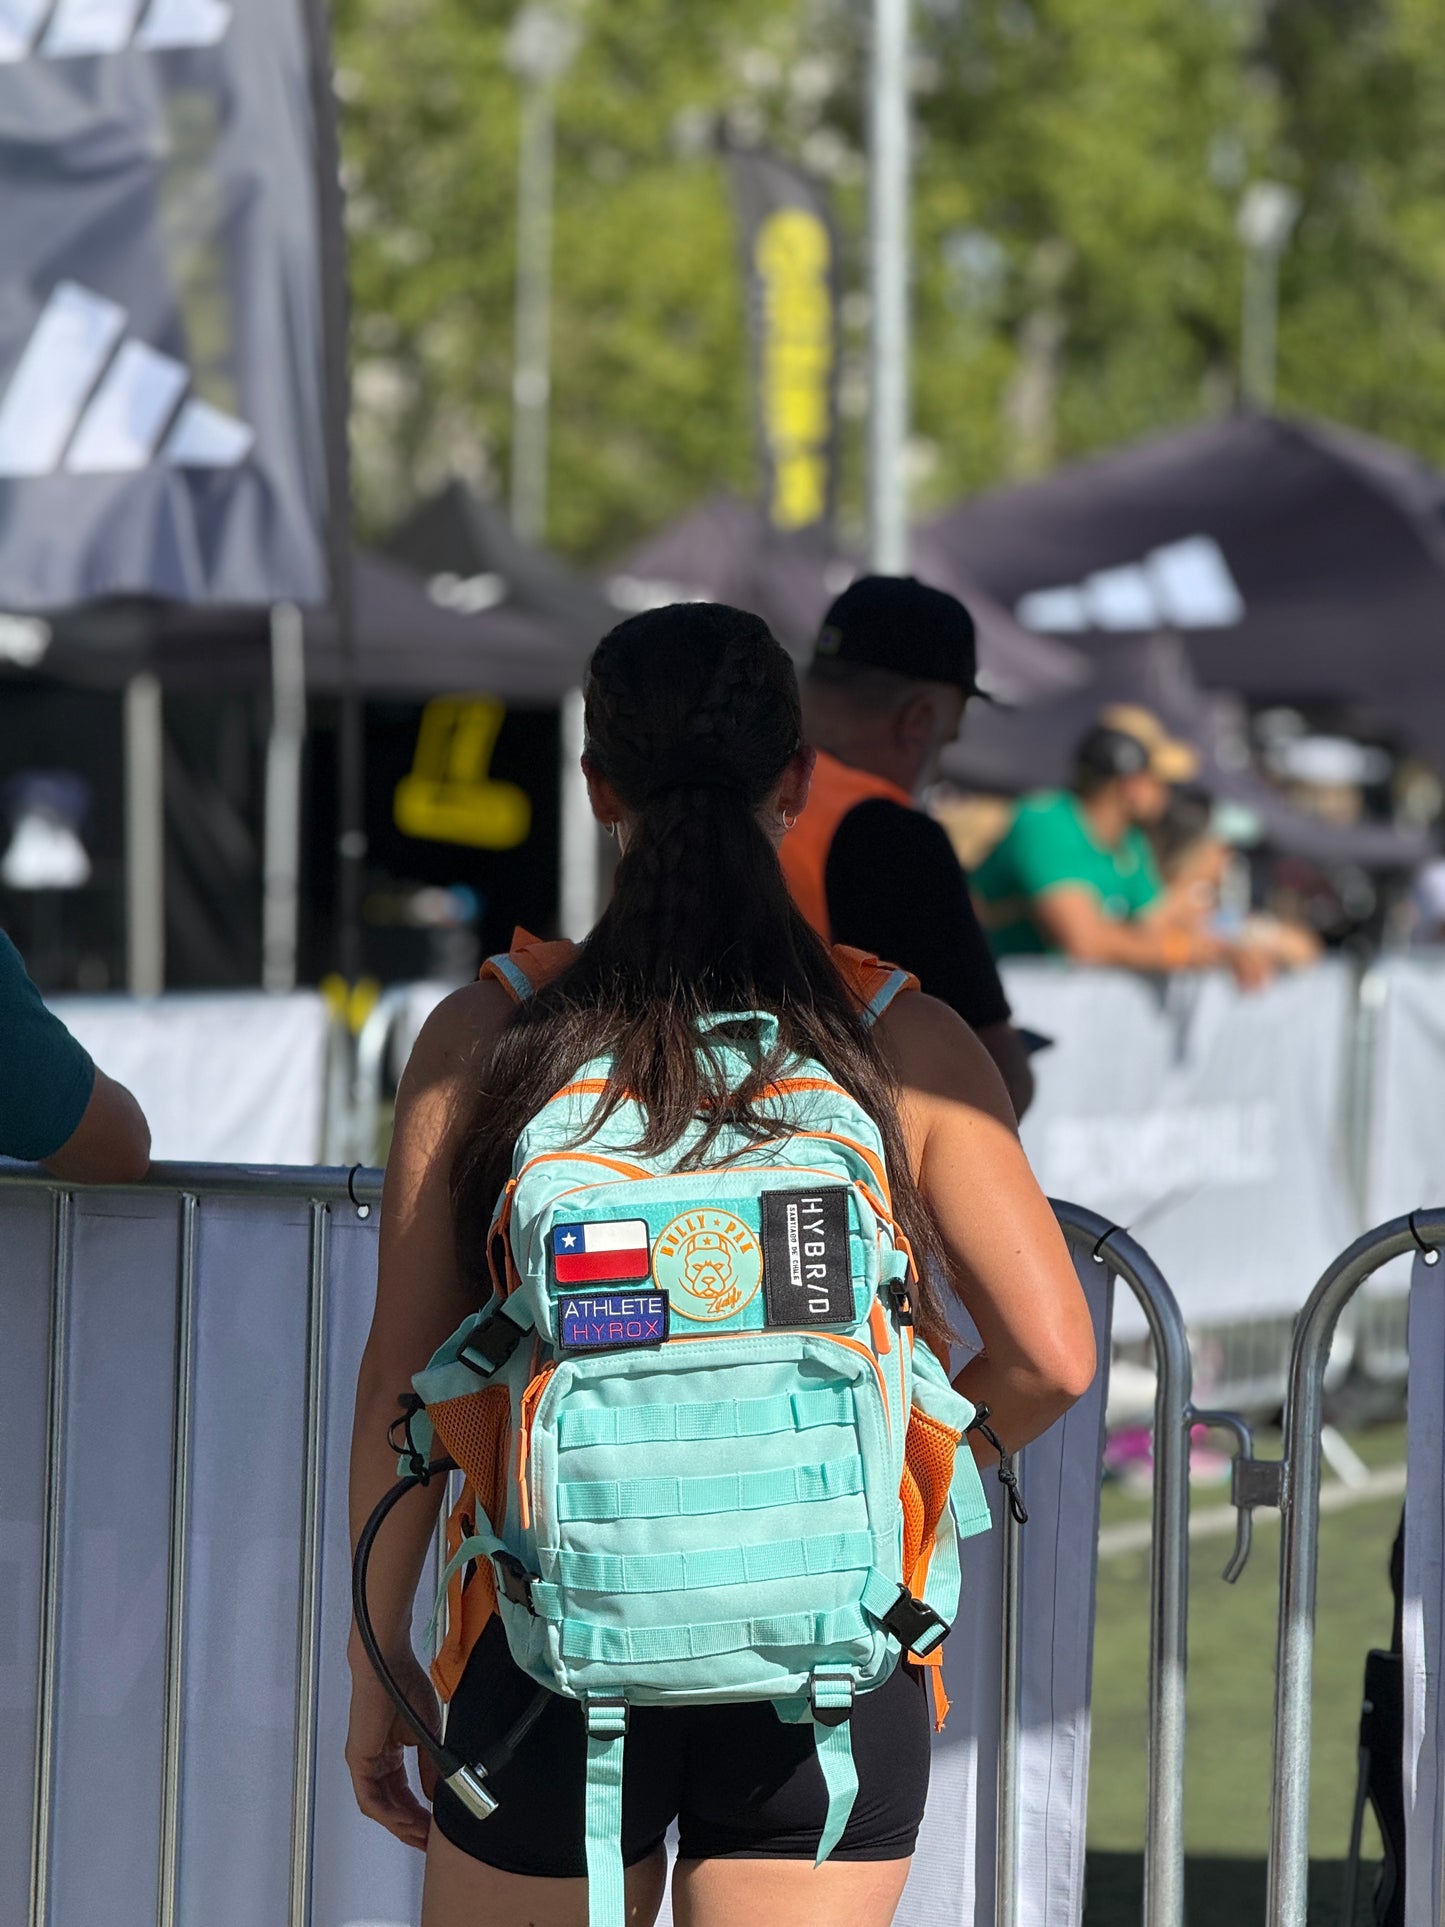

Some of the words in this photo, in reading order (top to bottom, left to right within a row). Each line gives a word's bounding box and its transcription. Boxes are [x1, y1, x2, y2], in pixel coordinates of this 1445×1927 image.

[789, 1206, 797, 1243] SANTIAGO
[660, 1215, 705, 1257] BULLY
[791, 1246, 798, 1256] DE
[801, 1197, 830, 1314] HYBR/D
[792, 1259, 800, 1281] CHILE
[564, 1297, 662, 1319] ATHLETE
[572, 1319, 659, 1341] HYROX
